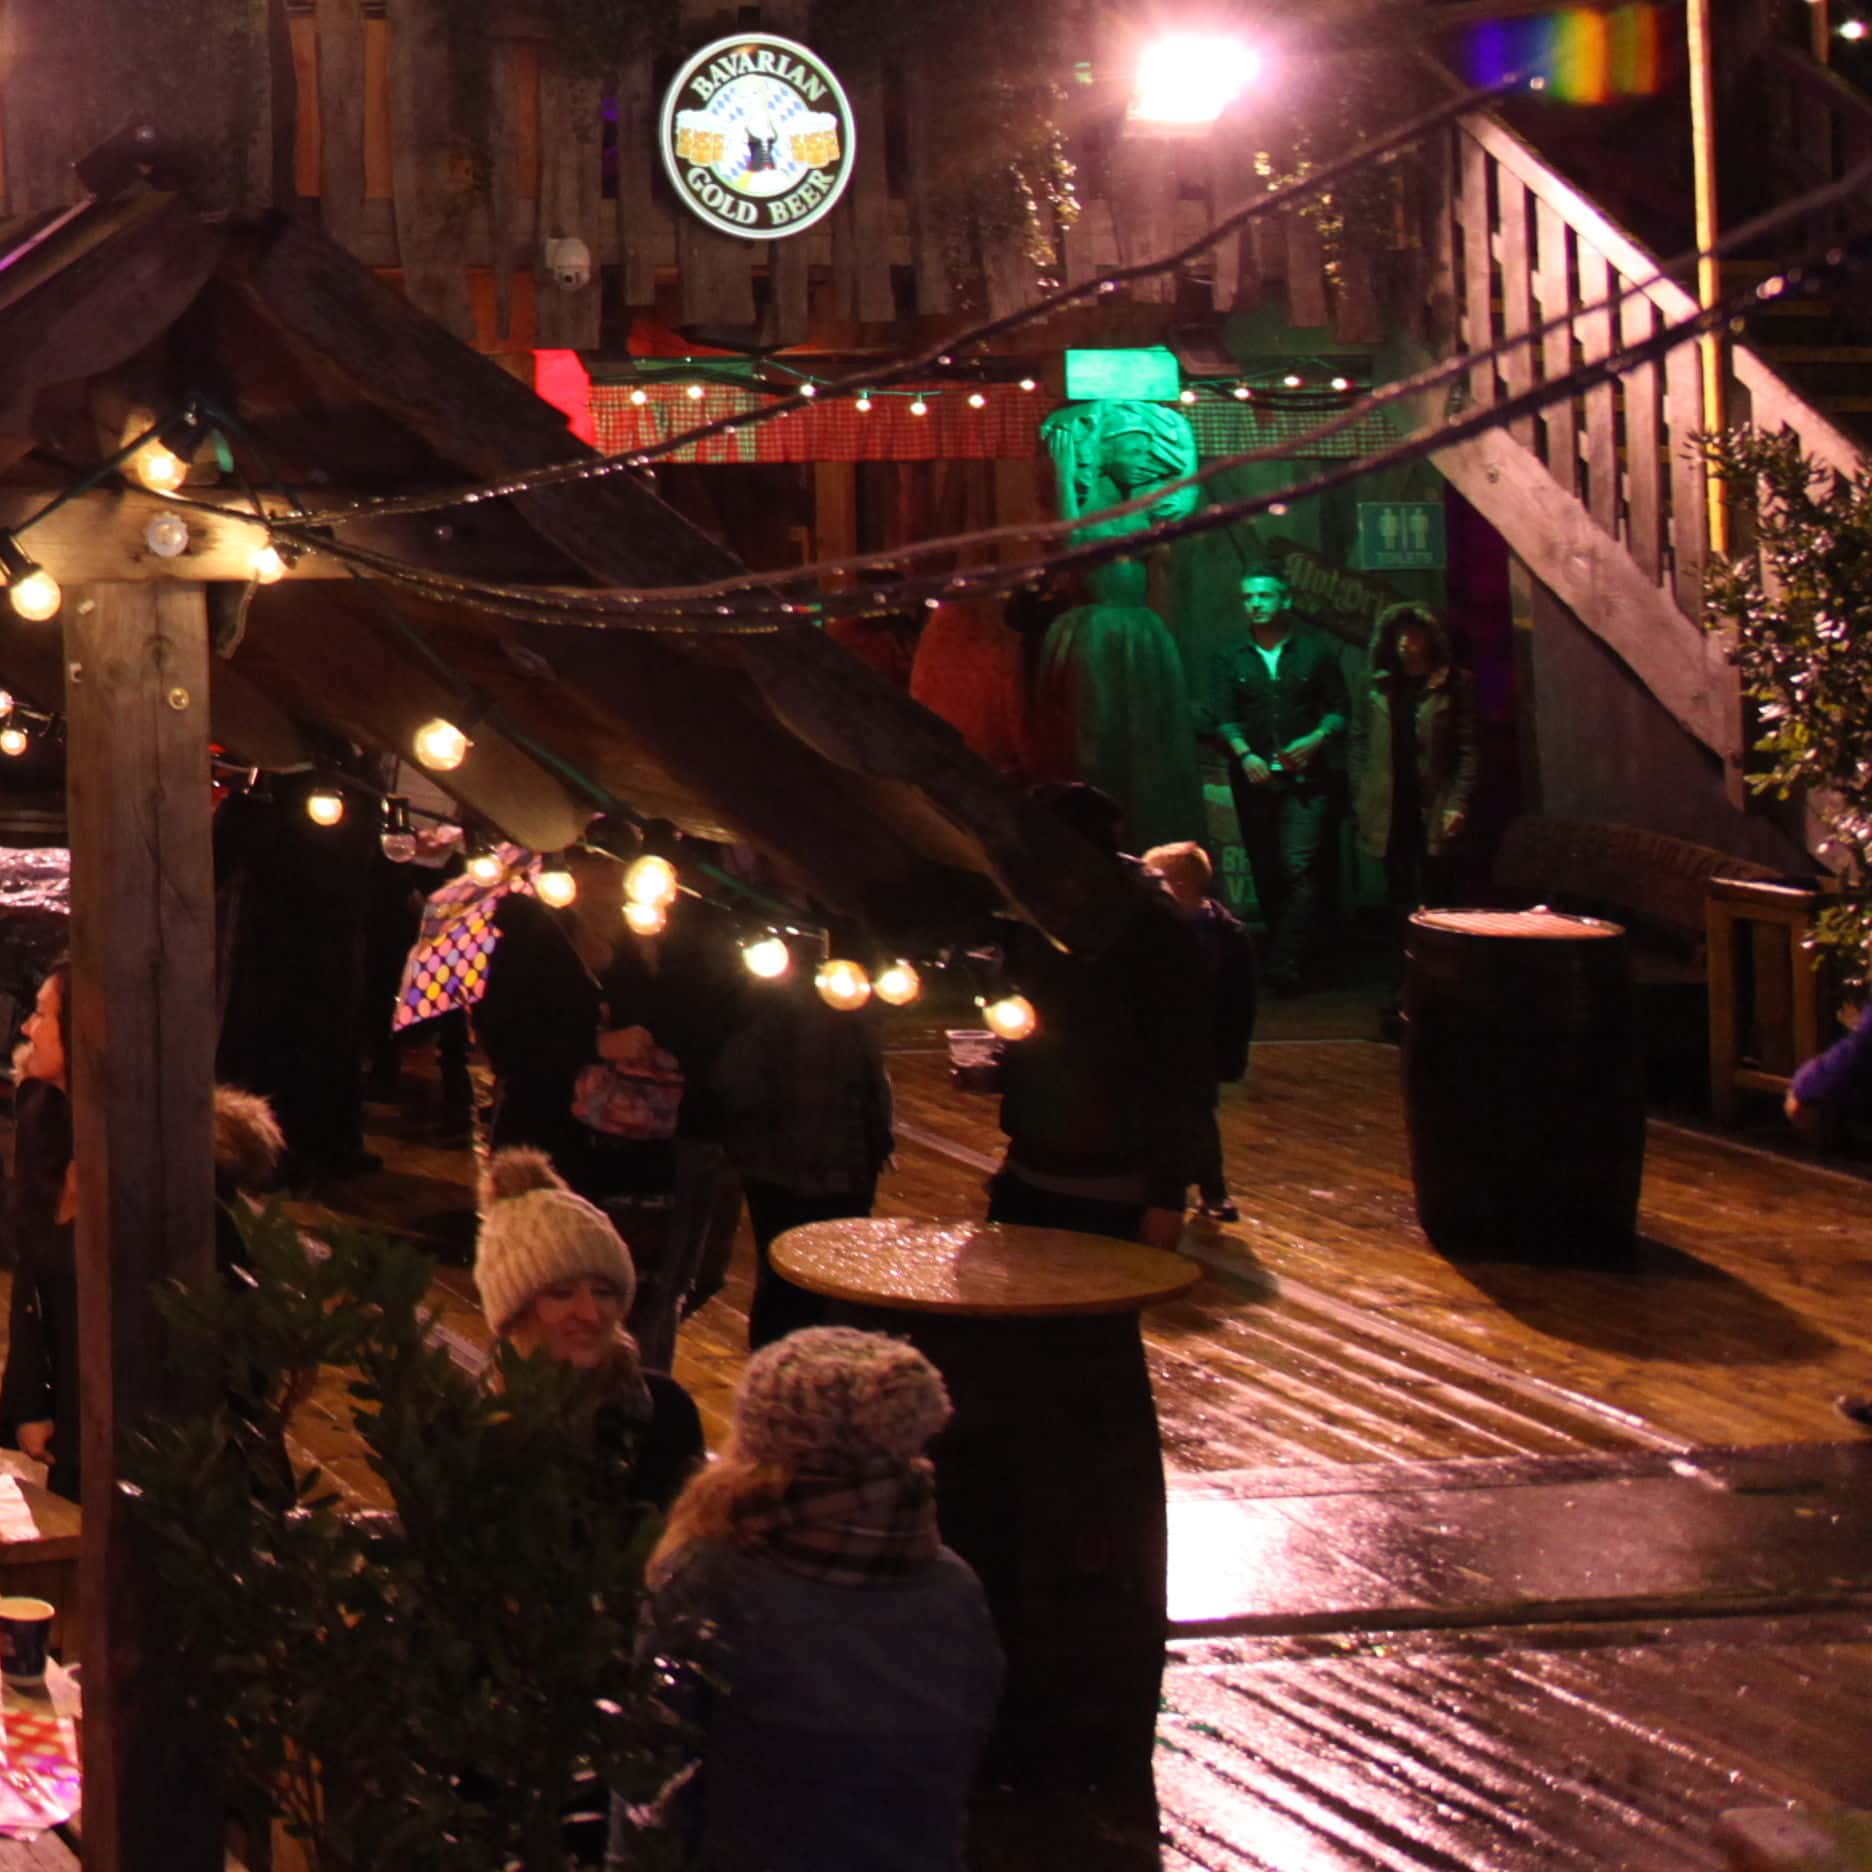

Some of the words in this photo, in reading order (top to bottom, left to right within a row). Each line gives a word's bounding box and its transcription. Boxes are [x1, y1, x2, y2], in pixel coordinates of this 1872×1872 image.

[690, 49, 828, 102] BAVARIAN
[686, 167, 758, 224] GOLD
[766, 169, 835, 225] BEER
